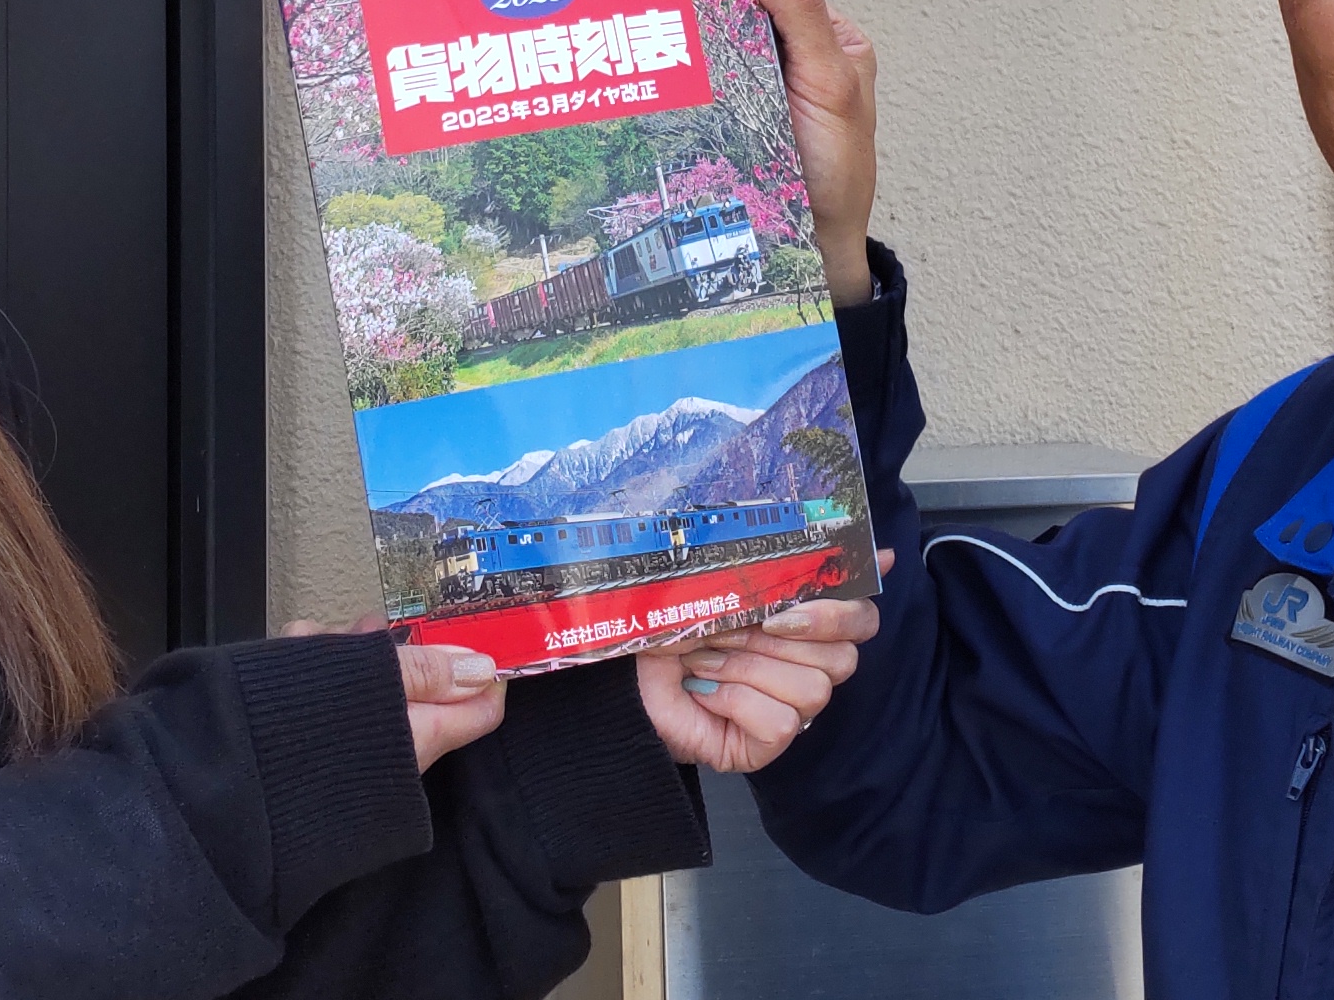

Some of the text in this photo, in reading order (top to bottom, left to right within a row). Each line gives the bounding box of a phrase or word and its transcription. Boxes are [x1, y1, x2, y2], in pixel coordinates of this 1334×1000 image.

[386, 9, 691, 111] 貨物時刻表
[442, 80, 659, 132] 2023年3月ダイヤ改正
[544, 593, 740, 650] 公益社団法人 鉄道貨物協会
[1262, 584, 1309, 623] JR
